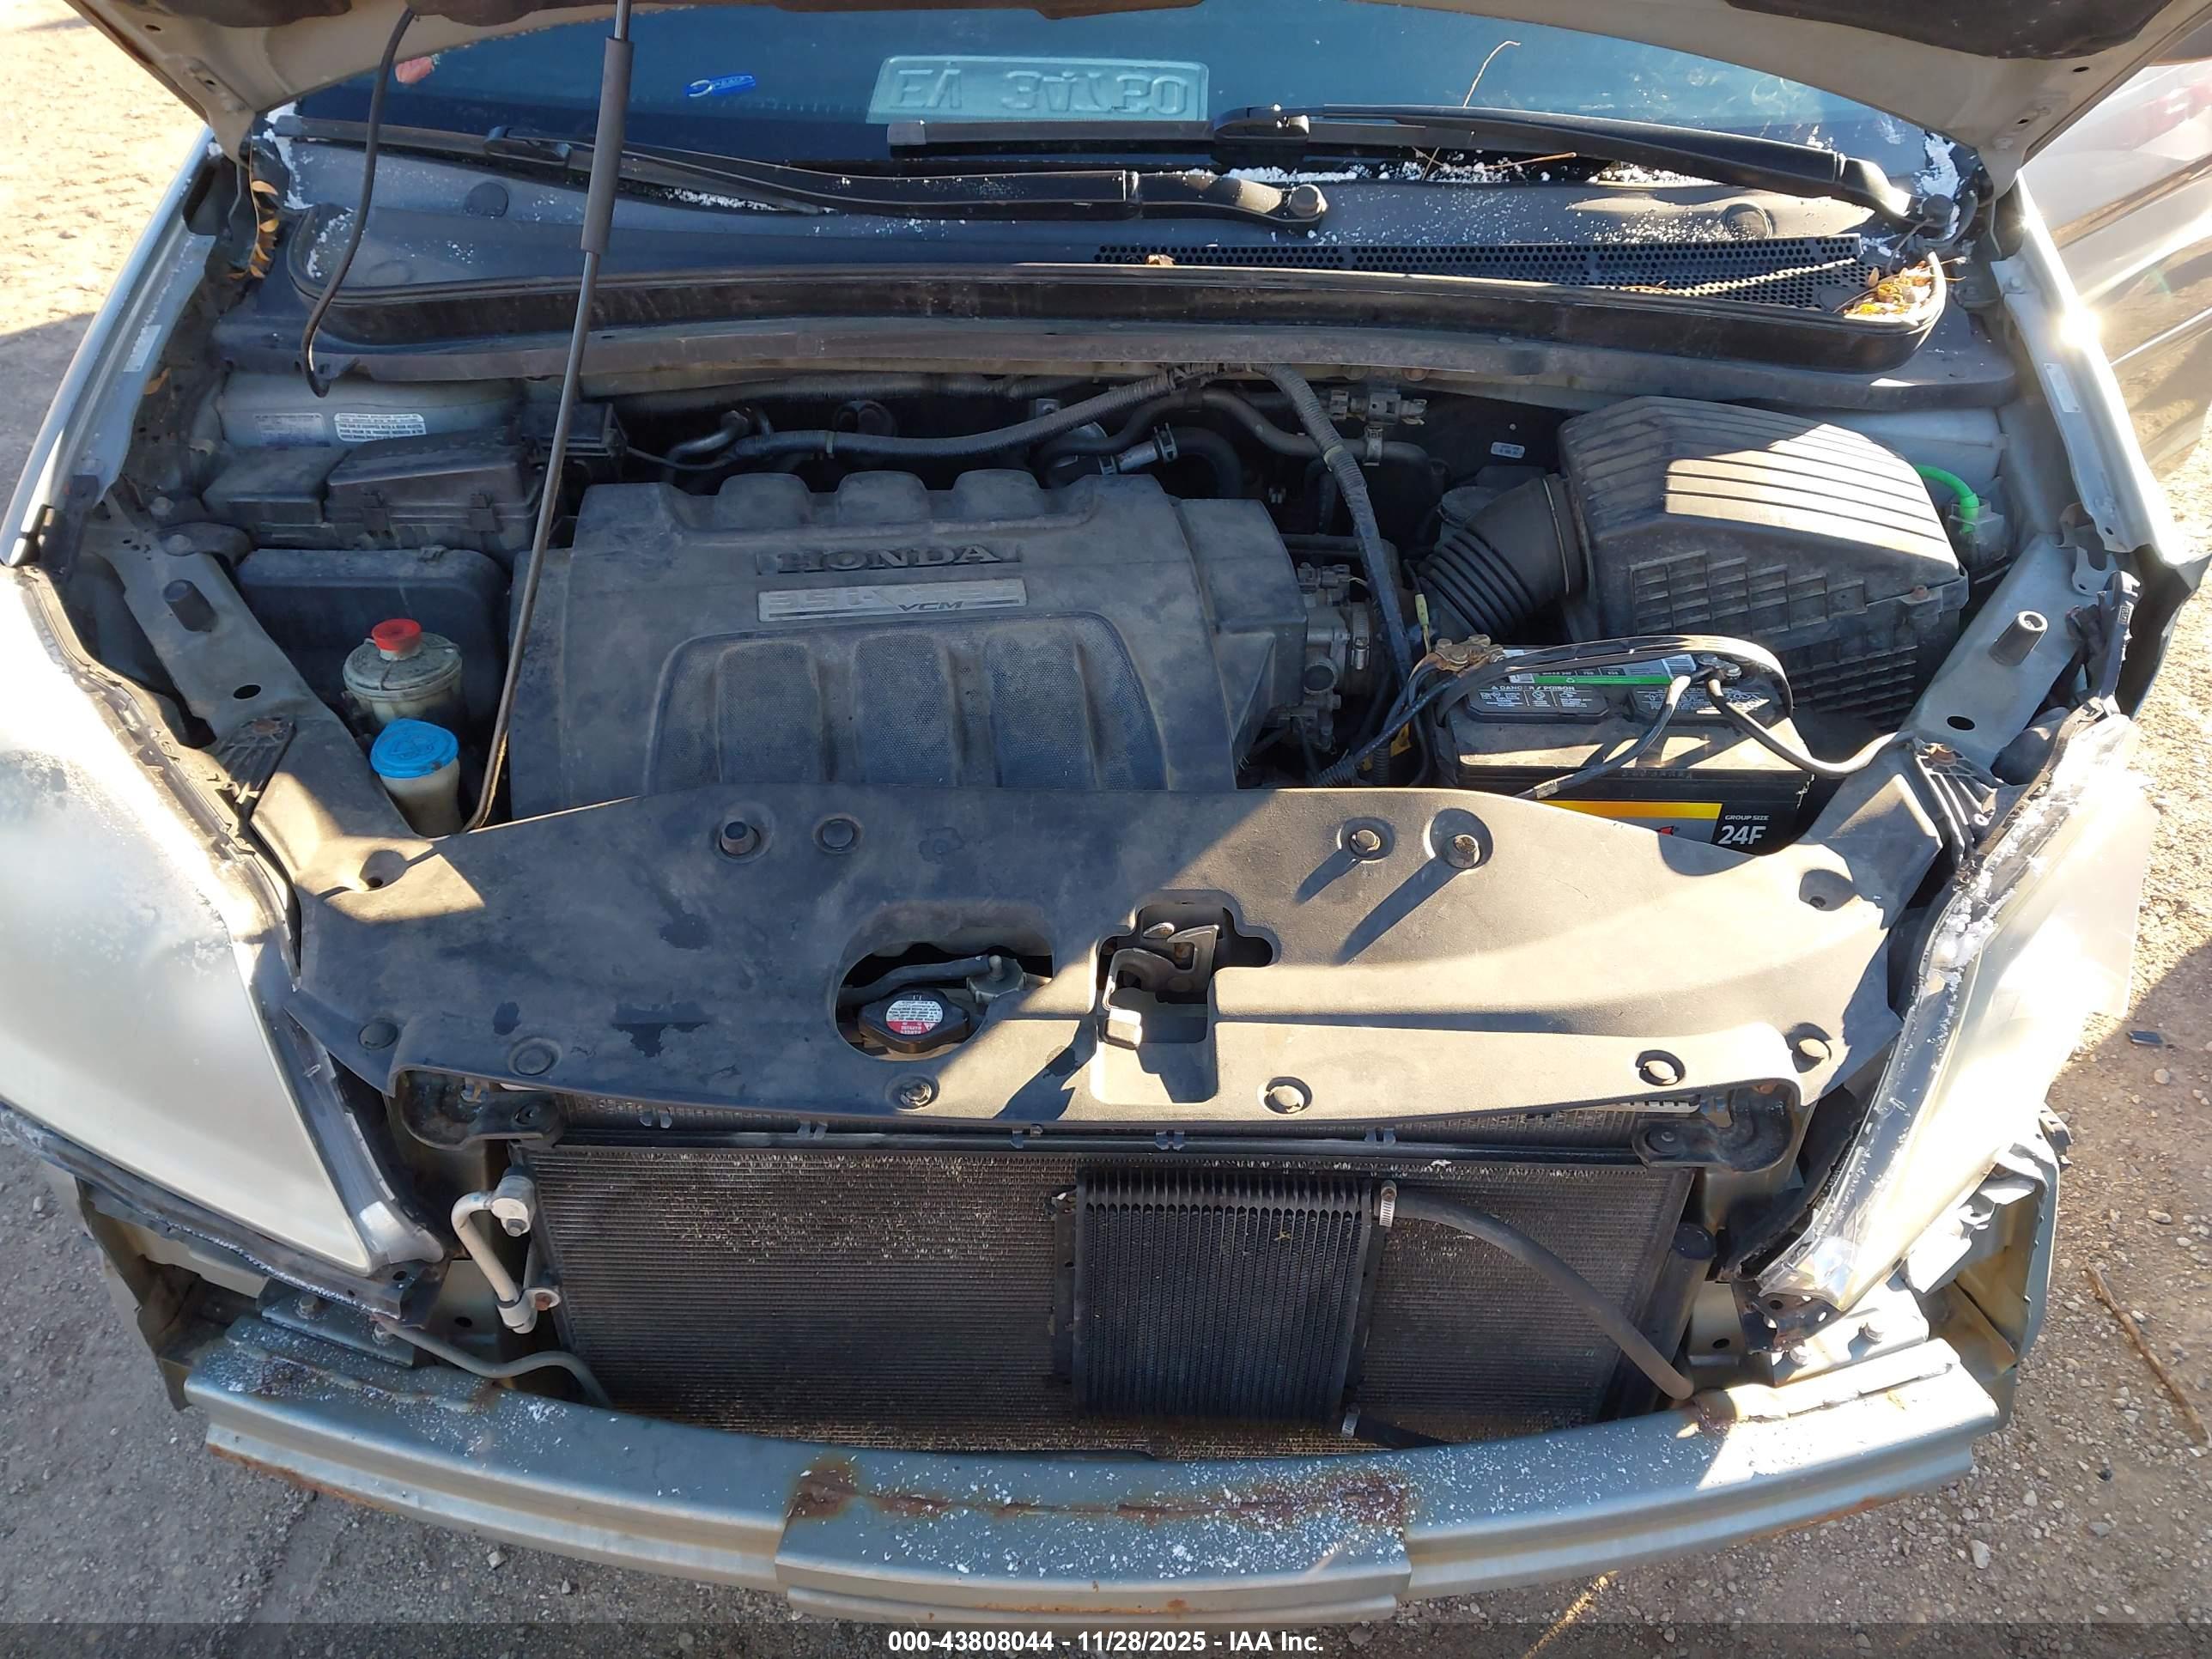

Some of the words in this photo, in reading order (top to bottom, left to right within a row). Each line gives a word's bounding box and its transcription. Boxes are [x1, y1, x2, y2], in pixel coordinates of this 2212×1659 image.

[777, 543, 1003, 574] HONDA
[897, 600, 964, 612] VCM
[1717, 824, 1767, 845] 24F
